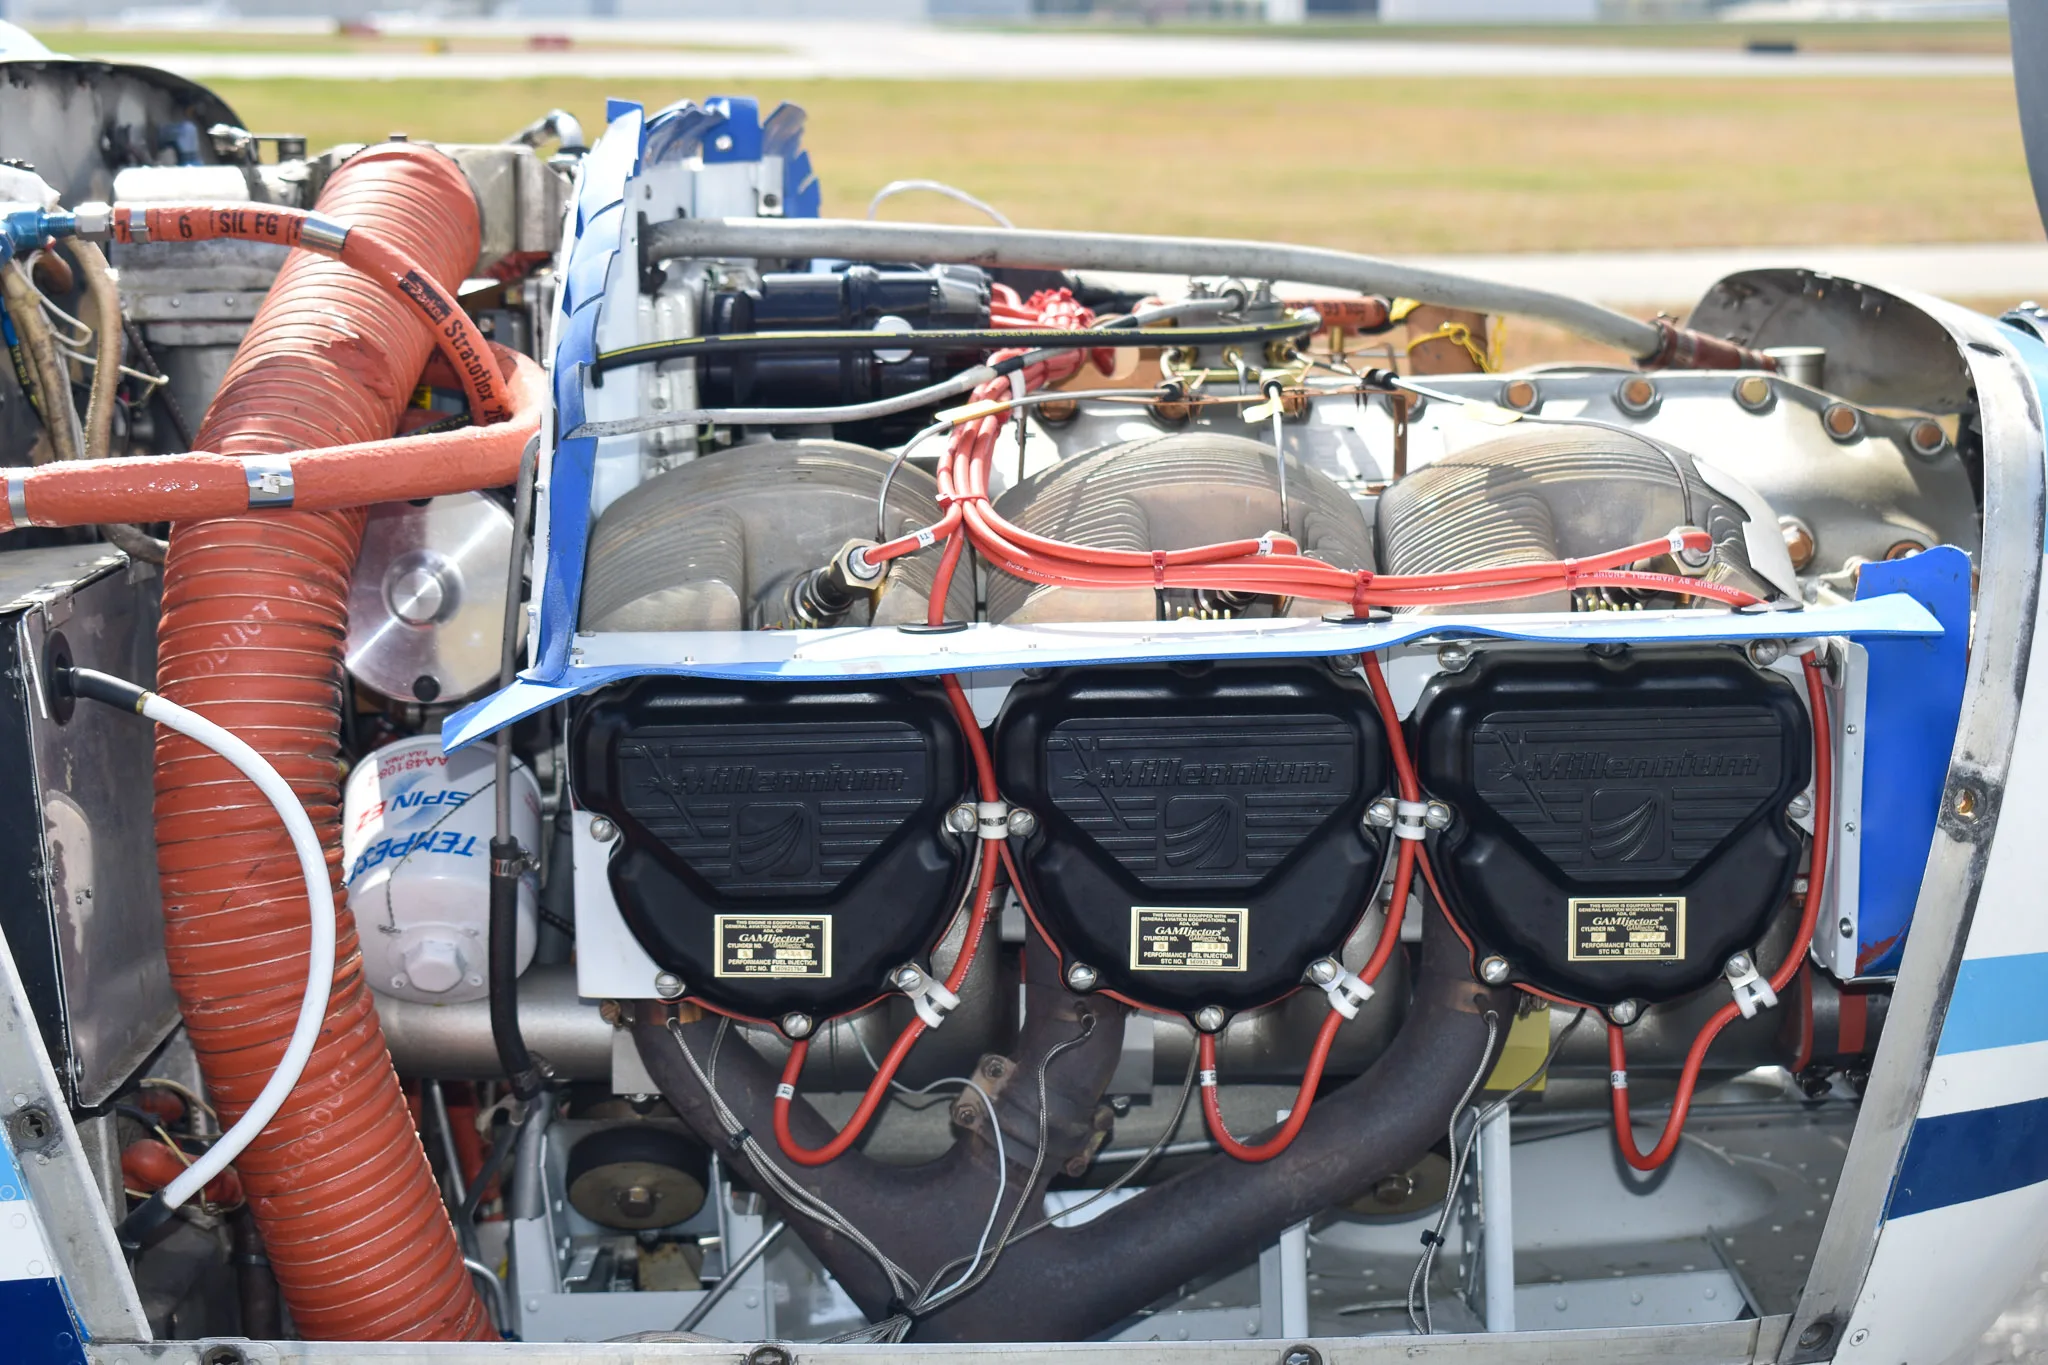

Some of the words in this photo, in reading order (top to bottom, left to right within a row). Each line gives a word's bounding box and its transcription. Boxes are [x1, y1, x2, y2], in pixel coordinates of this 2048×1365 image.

[178, 214, 193, 239] 6
[219, 212, 248, 235] SIL
[255, 213, 279, 236] FG
[1677, 576, 1692, 587] BY
[1695, 581, 1739, 596] POWERUP
[675, 763, 905, 795] Millennium
[1102, 756, 1334, 788] Millennium
[1529, 750, 1760, 781] Millennium
[391, 790, 473, 813] SPIN
